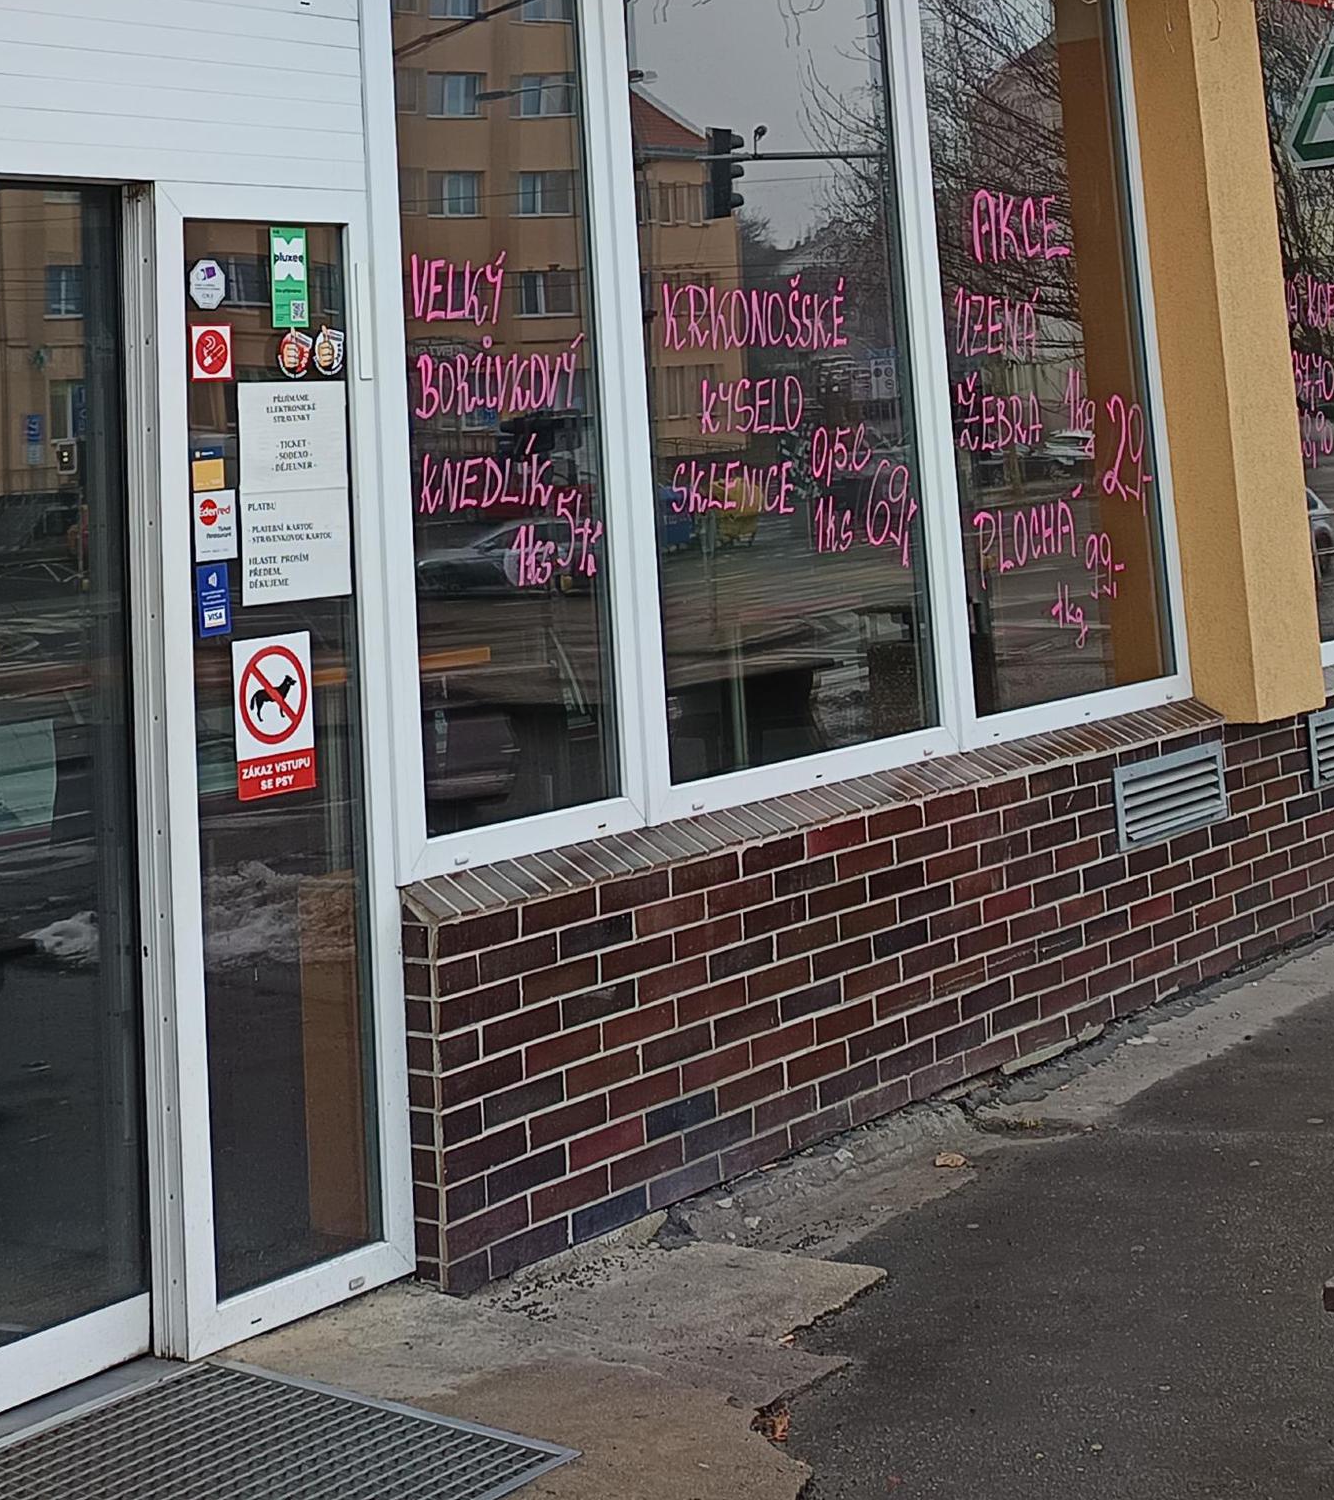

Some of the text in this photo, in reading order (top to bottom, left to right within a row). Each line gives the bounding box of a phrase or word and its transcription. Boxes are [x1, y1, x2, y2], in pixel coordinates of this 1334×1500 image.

[973, 189, 1070, 265] AKCE
[411, 251, 507, 326] VELKÝ
[663, 274, 847, 350] KRKONOŠSKÉ
[955, 287, 1040, 356] UZENÁ
[416, 333, 585, 419] BORŮVKOVÝ
[701, 376, 803, 434] KYSELO
[958, 372, 1043, 451] ŽEBRA
[420, 434, 553, 514] KNEDLÍK
[672, 461, 795, 513] SKLENICE
[974, 484, 1082, 589] PLOCHÁ
[207, 612, 223, 621] VISA
[242, 756, 311, 780] ZÁKAZ VSTUPU
[261, 774, 295, 790] SE PSY
